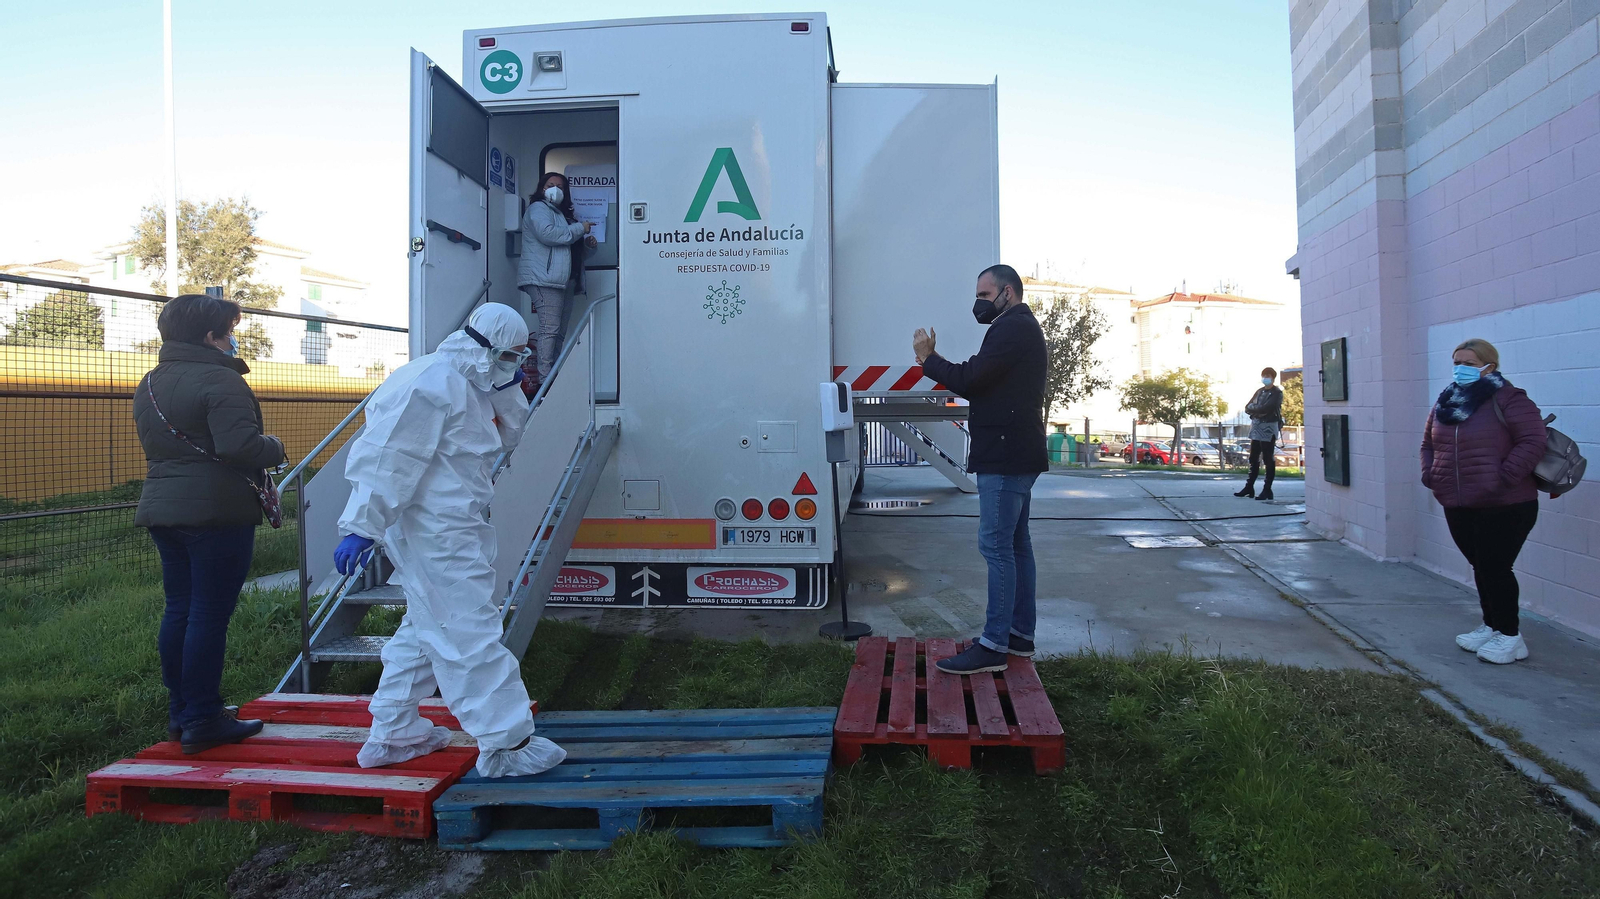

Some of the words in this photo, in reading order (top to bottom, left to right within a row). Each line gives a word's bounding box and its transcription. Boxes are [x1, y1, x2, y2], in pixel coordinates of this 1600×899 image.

[484, 62, 519, 82] C3
[567, 176, 616, 186] ENTRADA
[642, 230, 690, 244] Junta
[694, 227, 715, 242] de
[719, 223, 804, 242] Andalucía
[658, 248, 704, 259] Consejería
[705, 249, 717, 257] de
[719, 248, 743, 257] Salud
[744, 250, 751, 258] y
[752, 247, 789, 256] Familias
[677, 264, 728, 273] RESPUESTA
[729, 263, 770, 272] COVID-19
[740, 529, 771, 543] 1979
[780, 530, 804, 543] HGW
